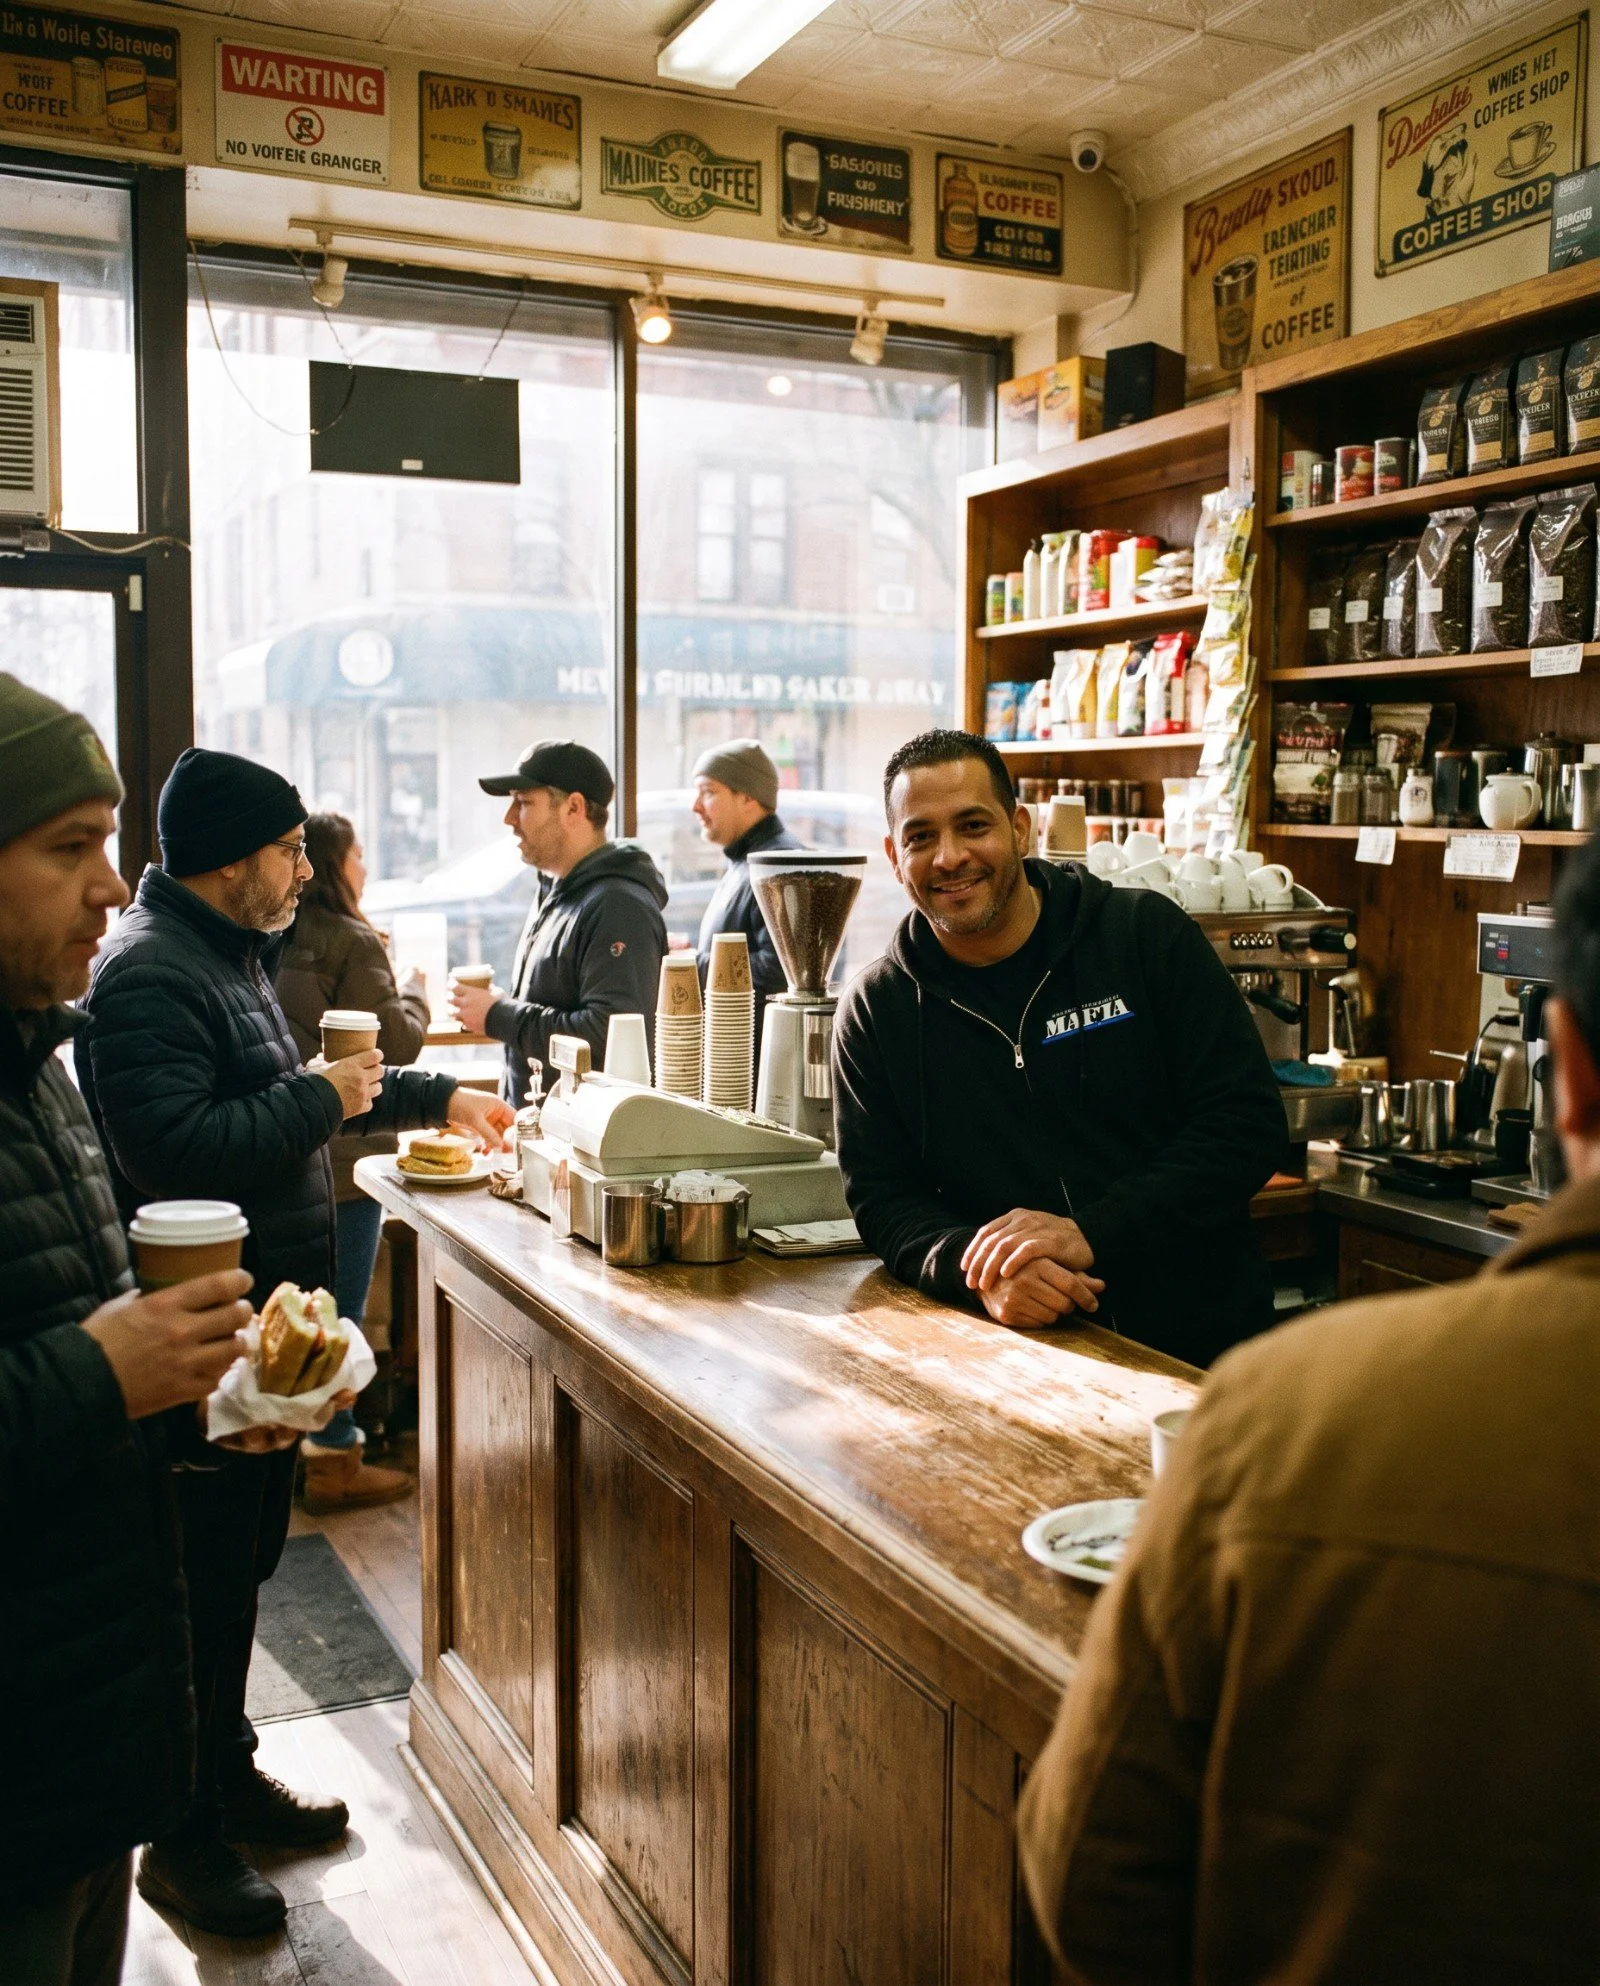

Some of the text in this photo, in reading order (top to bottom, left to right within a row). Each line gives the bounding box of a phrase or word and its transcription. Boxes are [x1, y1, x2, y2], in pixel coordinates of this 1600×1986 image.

[229, 54, 378, 106] WARTING
[1473, 70, 1570, 129] COFFEE SHOP
[3, 91, 69, 118] COFFEE
[226, 139, 247, 156] NO
[311, 153, 382, 174] GRANGER
[689, 166, 755, 205] COFFEE
[983, 191, 1056, 219] COFFEE
[1400, 204, 1484, 256] COFFEE
[1491, 180, 1553, 224] SHOP
[1261, 302, 1335, 350] COFFEE
[1046, 999, 1129, 1039] MAFIA
